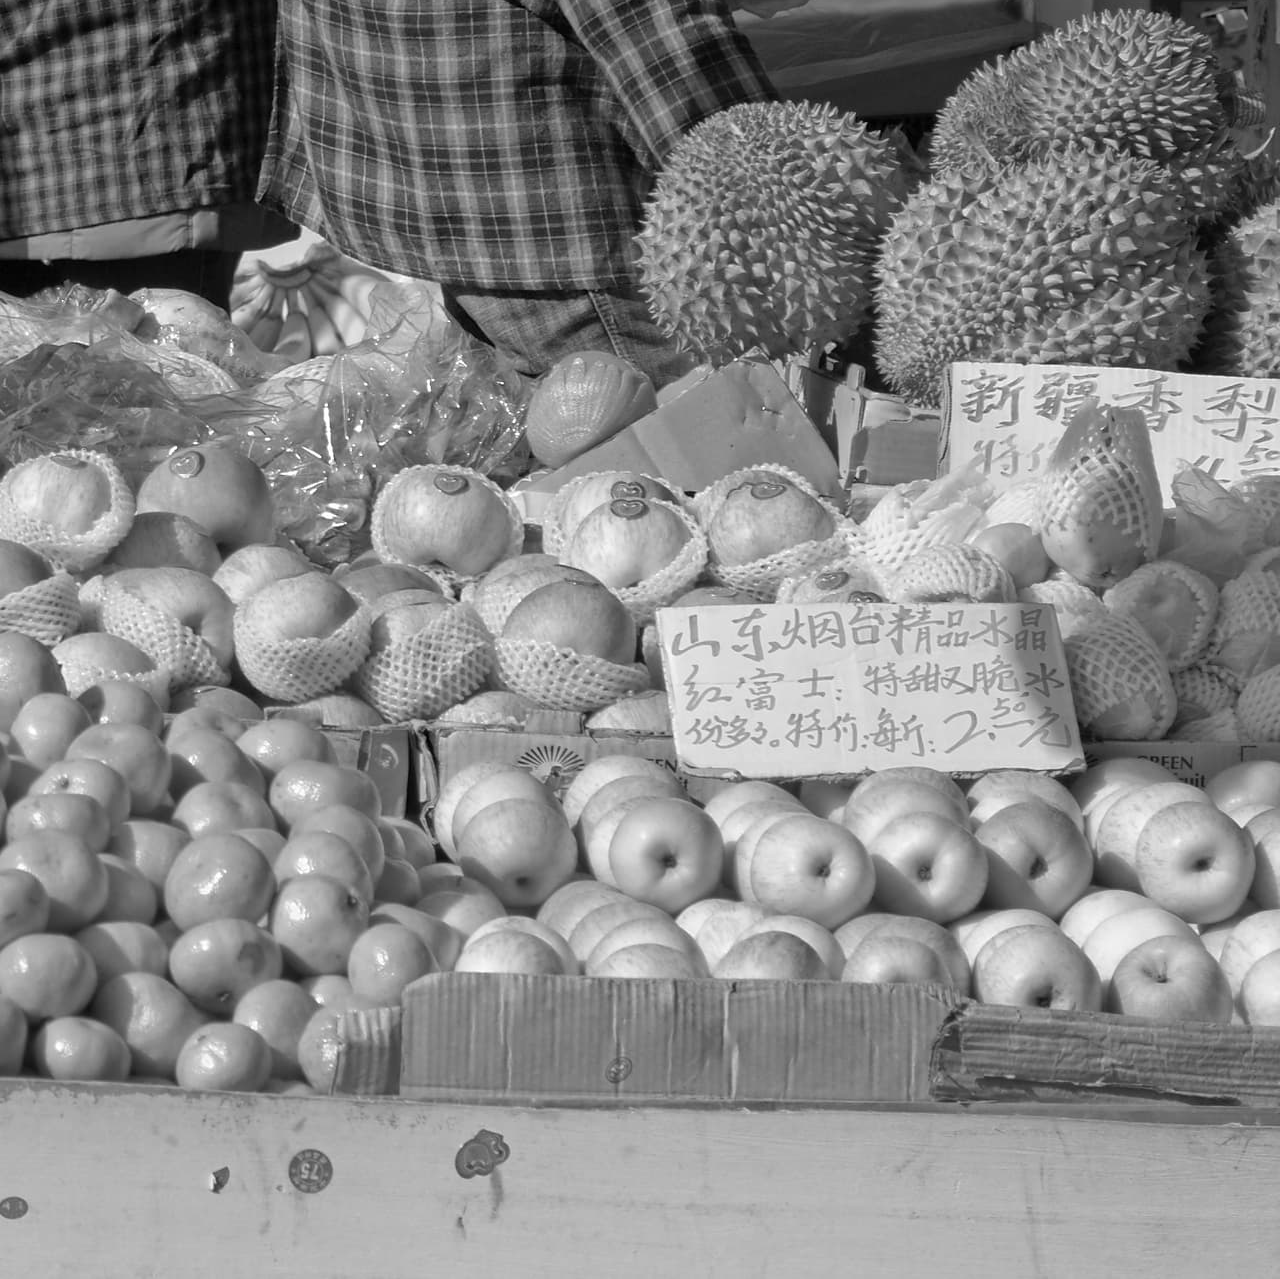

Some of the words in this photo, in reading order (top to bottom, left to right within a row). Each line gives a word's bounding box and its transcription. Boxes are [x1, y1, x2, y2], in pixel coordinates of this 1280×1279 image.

[671, 607, 1049, 661] 山东烟台精品水晶
